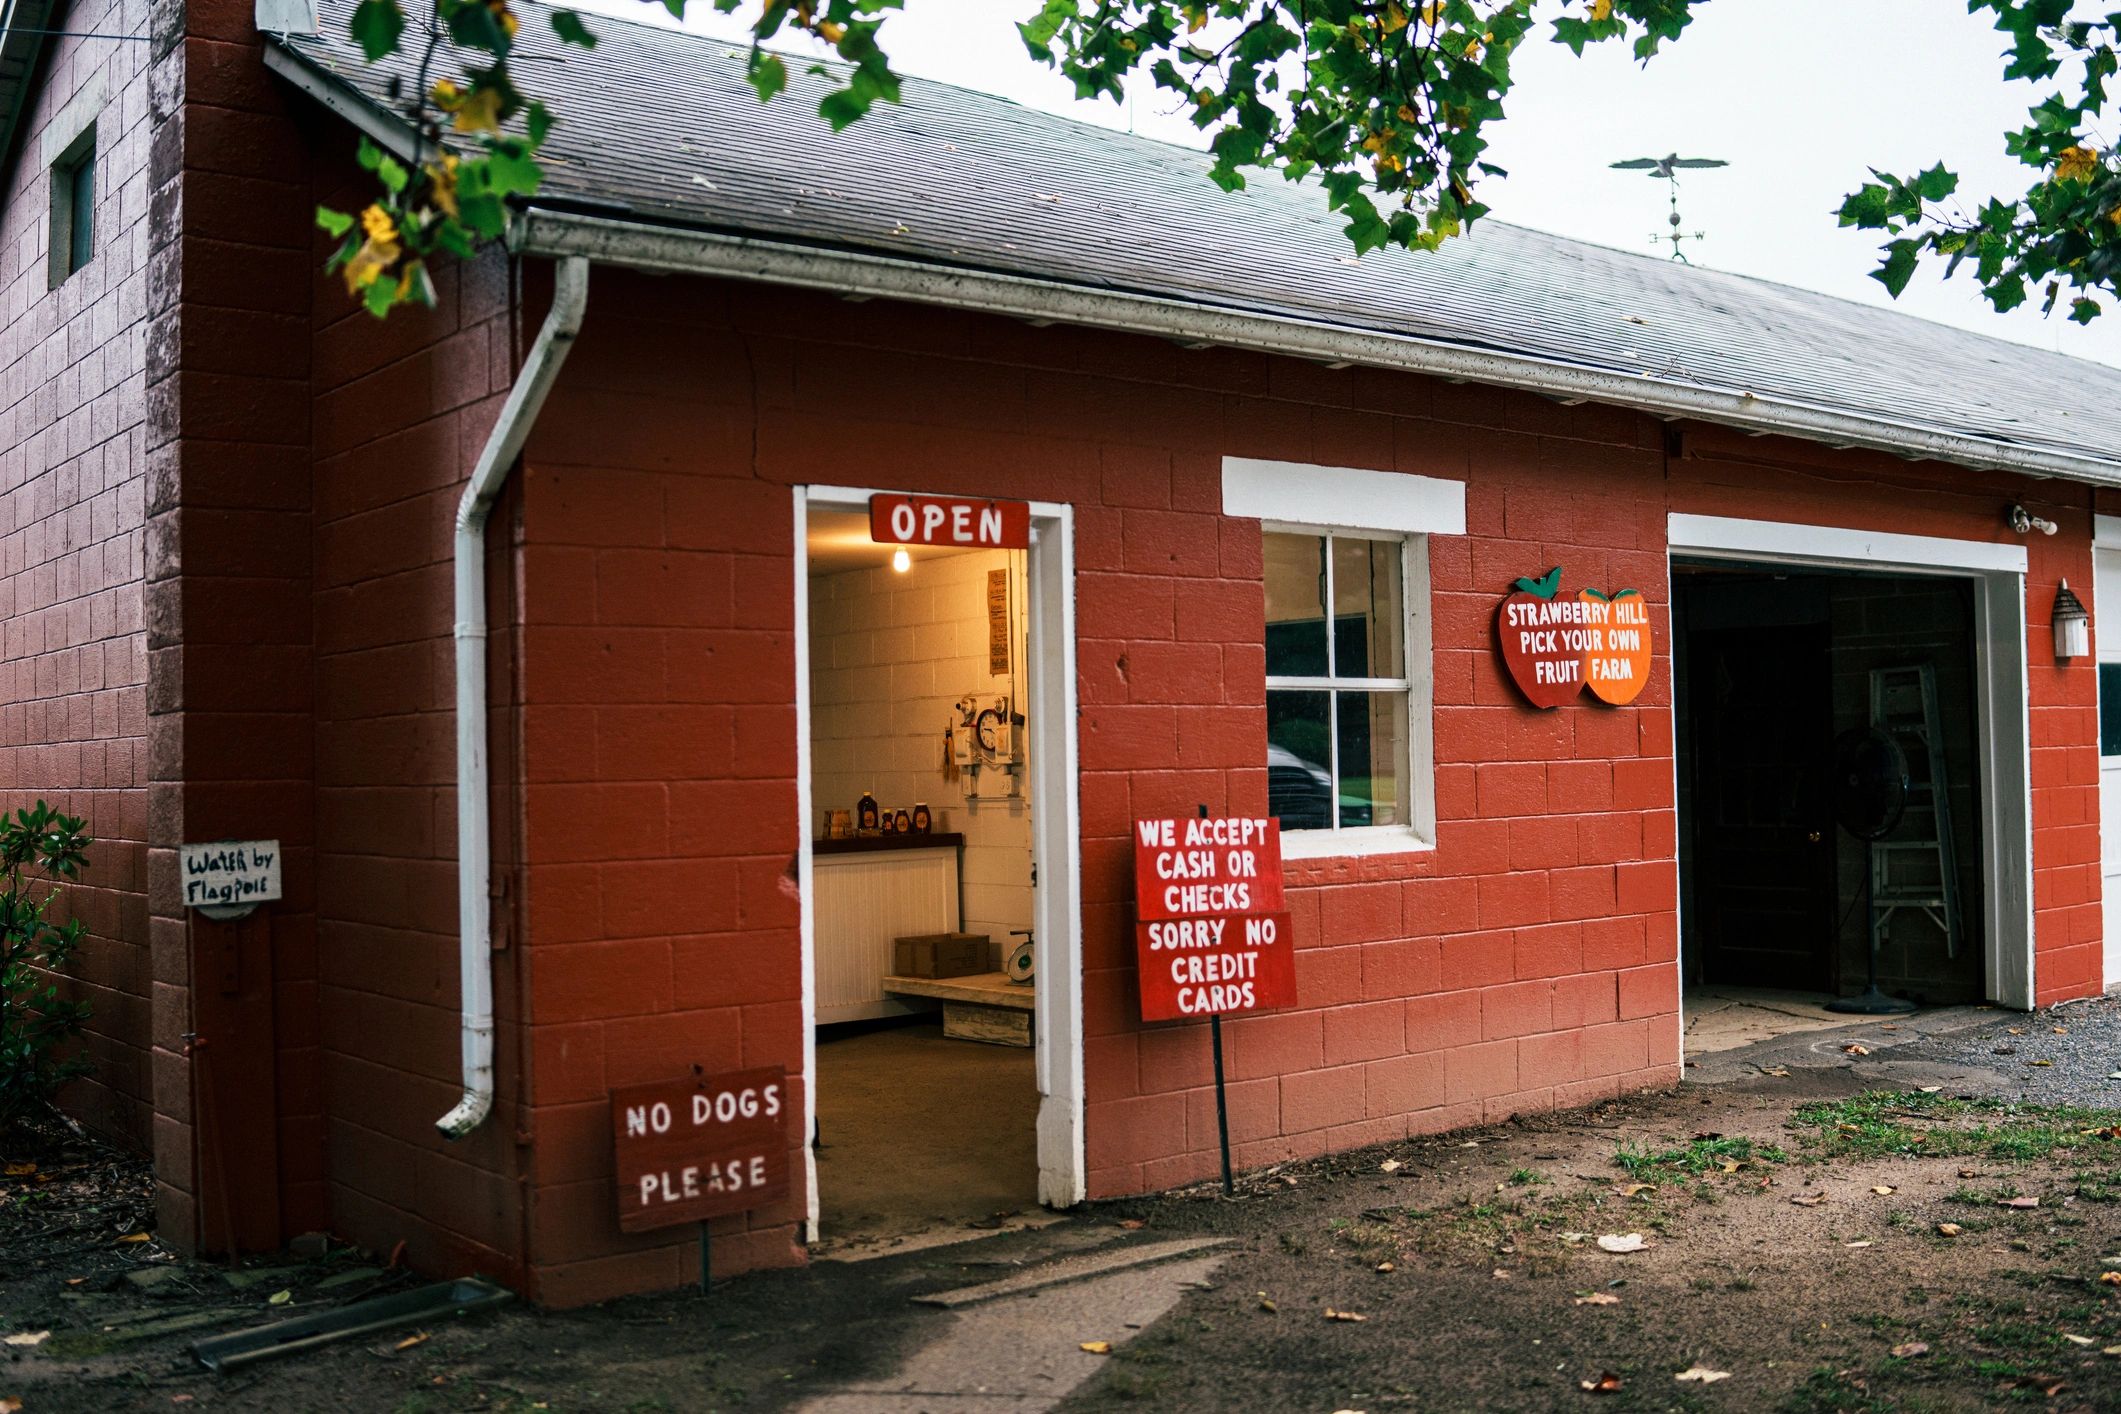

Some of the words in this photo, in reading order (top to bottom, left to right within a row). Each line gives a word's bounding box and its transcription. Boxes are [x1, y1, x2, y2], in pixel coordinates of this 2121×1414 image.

[891, 504, 1002, 544] OPEN
[1507, 602, 1610, 627] STRAWBERRY
[1616, 603, 1648, 624] HILL
[1520, 630, 1557, 654] PICK
[1561, 629, 1602, 652] YOUR
[1608, 630, 1640, 651] OWN
[1535, 660, 1579, 684] FRUIT
[1591, 658, 1633, 680] FARM
[1138, 819, 1176, 847] WE
[1185, 818, 1267, 847] ACCEPT
[253, 847, 274, 869] by
[1156, 850, 1215, 879] CASH
[1227, 850, 1256, 877] OR
[1164, 882, 1250, 913] CHECKS
[1149, 919, 1226, 950] SORRY
[1245, 919, 1275, 945] NO
[1171, 952, 1258, 984] CREDIT
[1178, 982, 1255, 1013] CARDS
[626, 1101, 672, 1138] NO
[692, 1084, 781, 1125] DOGS
[640, 1156, 767, 1206] PLEASE
